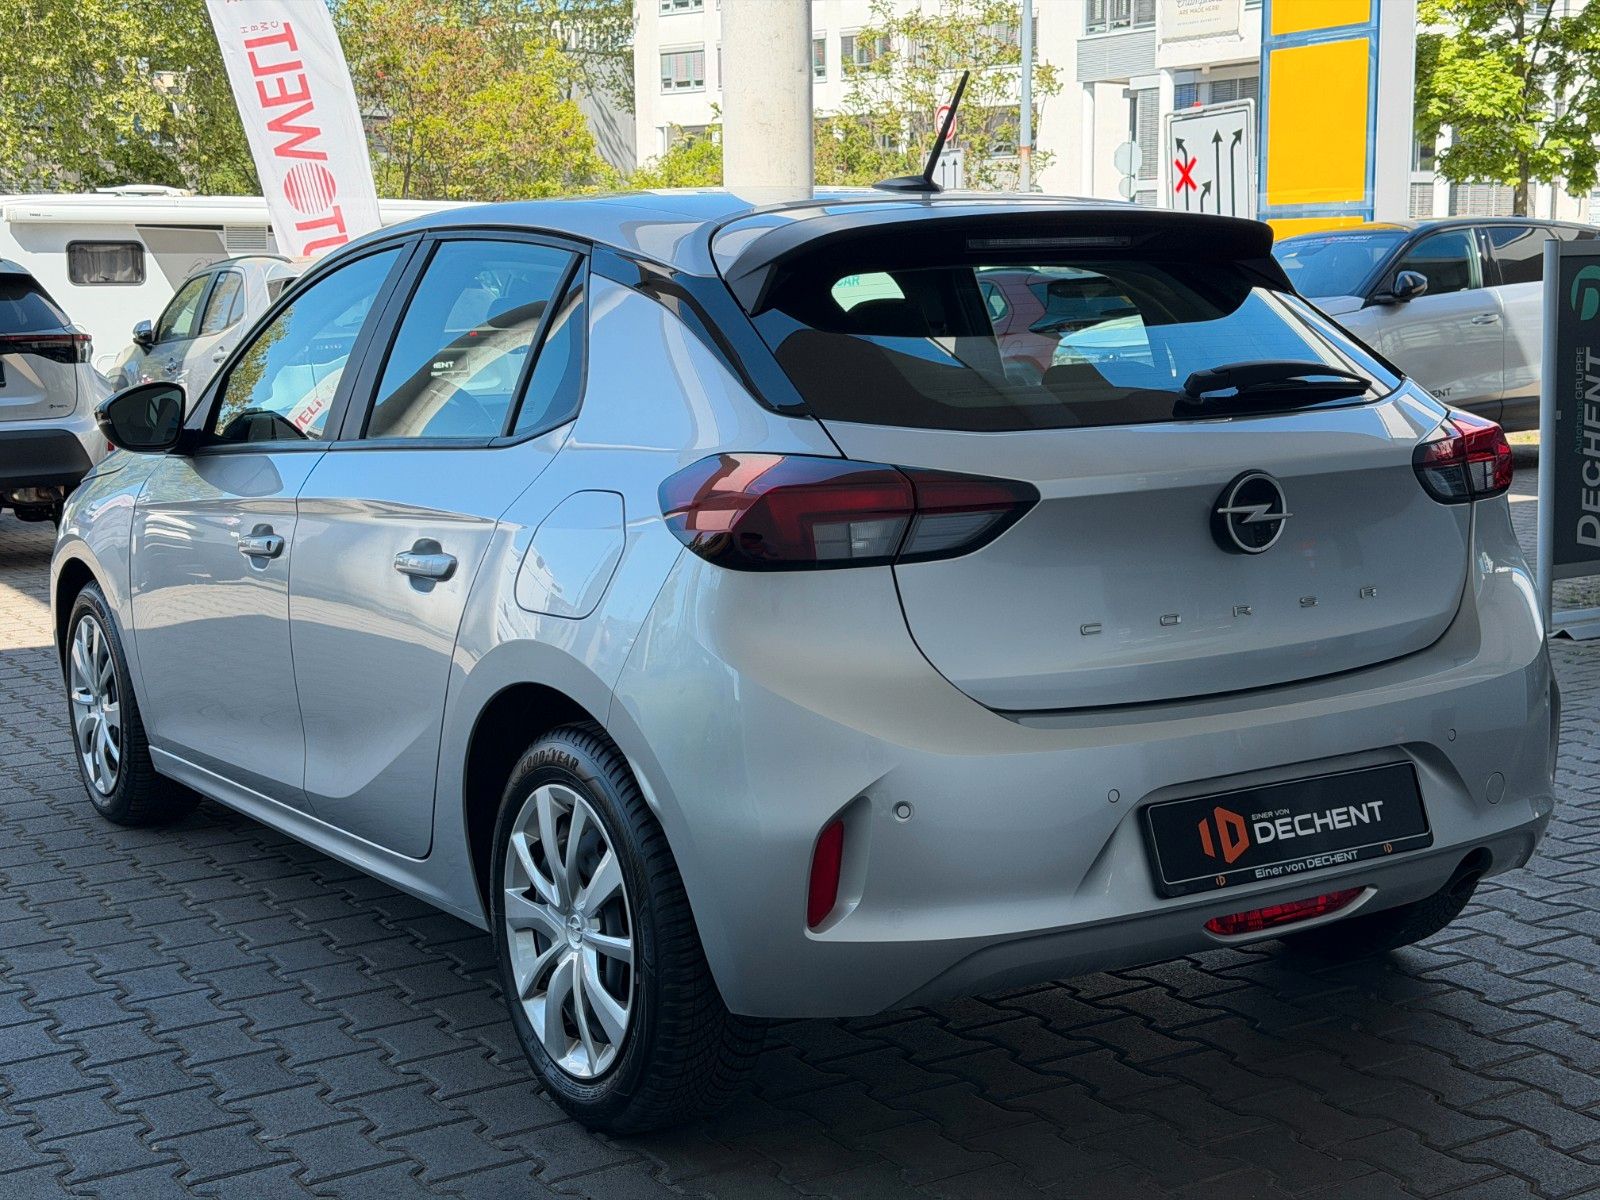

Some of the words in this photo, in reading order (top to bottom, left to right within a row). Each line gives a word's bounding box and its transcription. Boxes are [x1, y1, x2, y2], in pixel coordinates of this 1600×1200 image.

[1576, 346, 1600, 548] DECHENT
[1080, 586, 1377, 636] CORSA
[1251, 811, 1274, 821] EINER
[1274, 808, 1291, 817] VON
[1253, 801, 1384, 845] DECHENT
[1255, 866, 1283, 879] Einer
[1286, 862, 1306, 873] von
[1306, 850, 1359, 870] DECHENT
